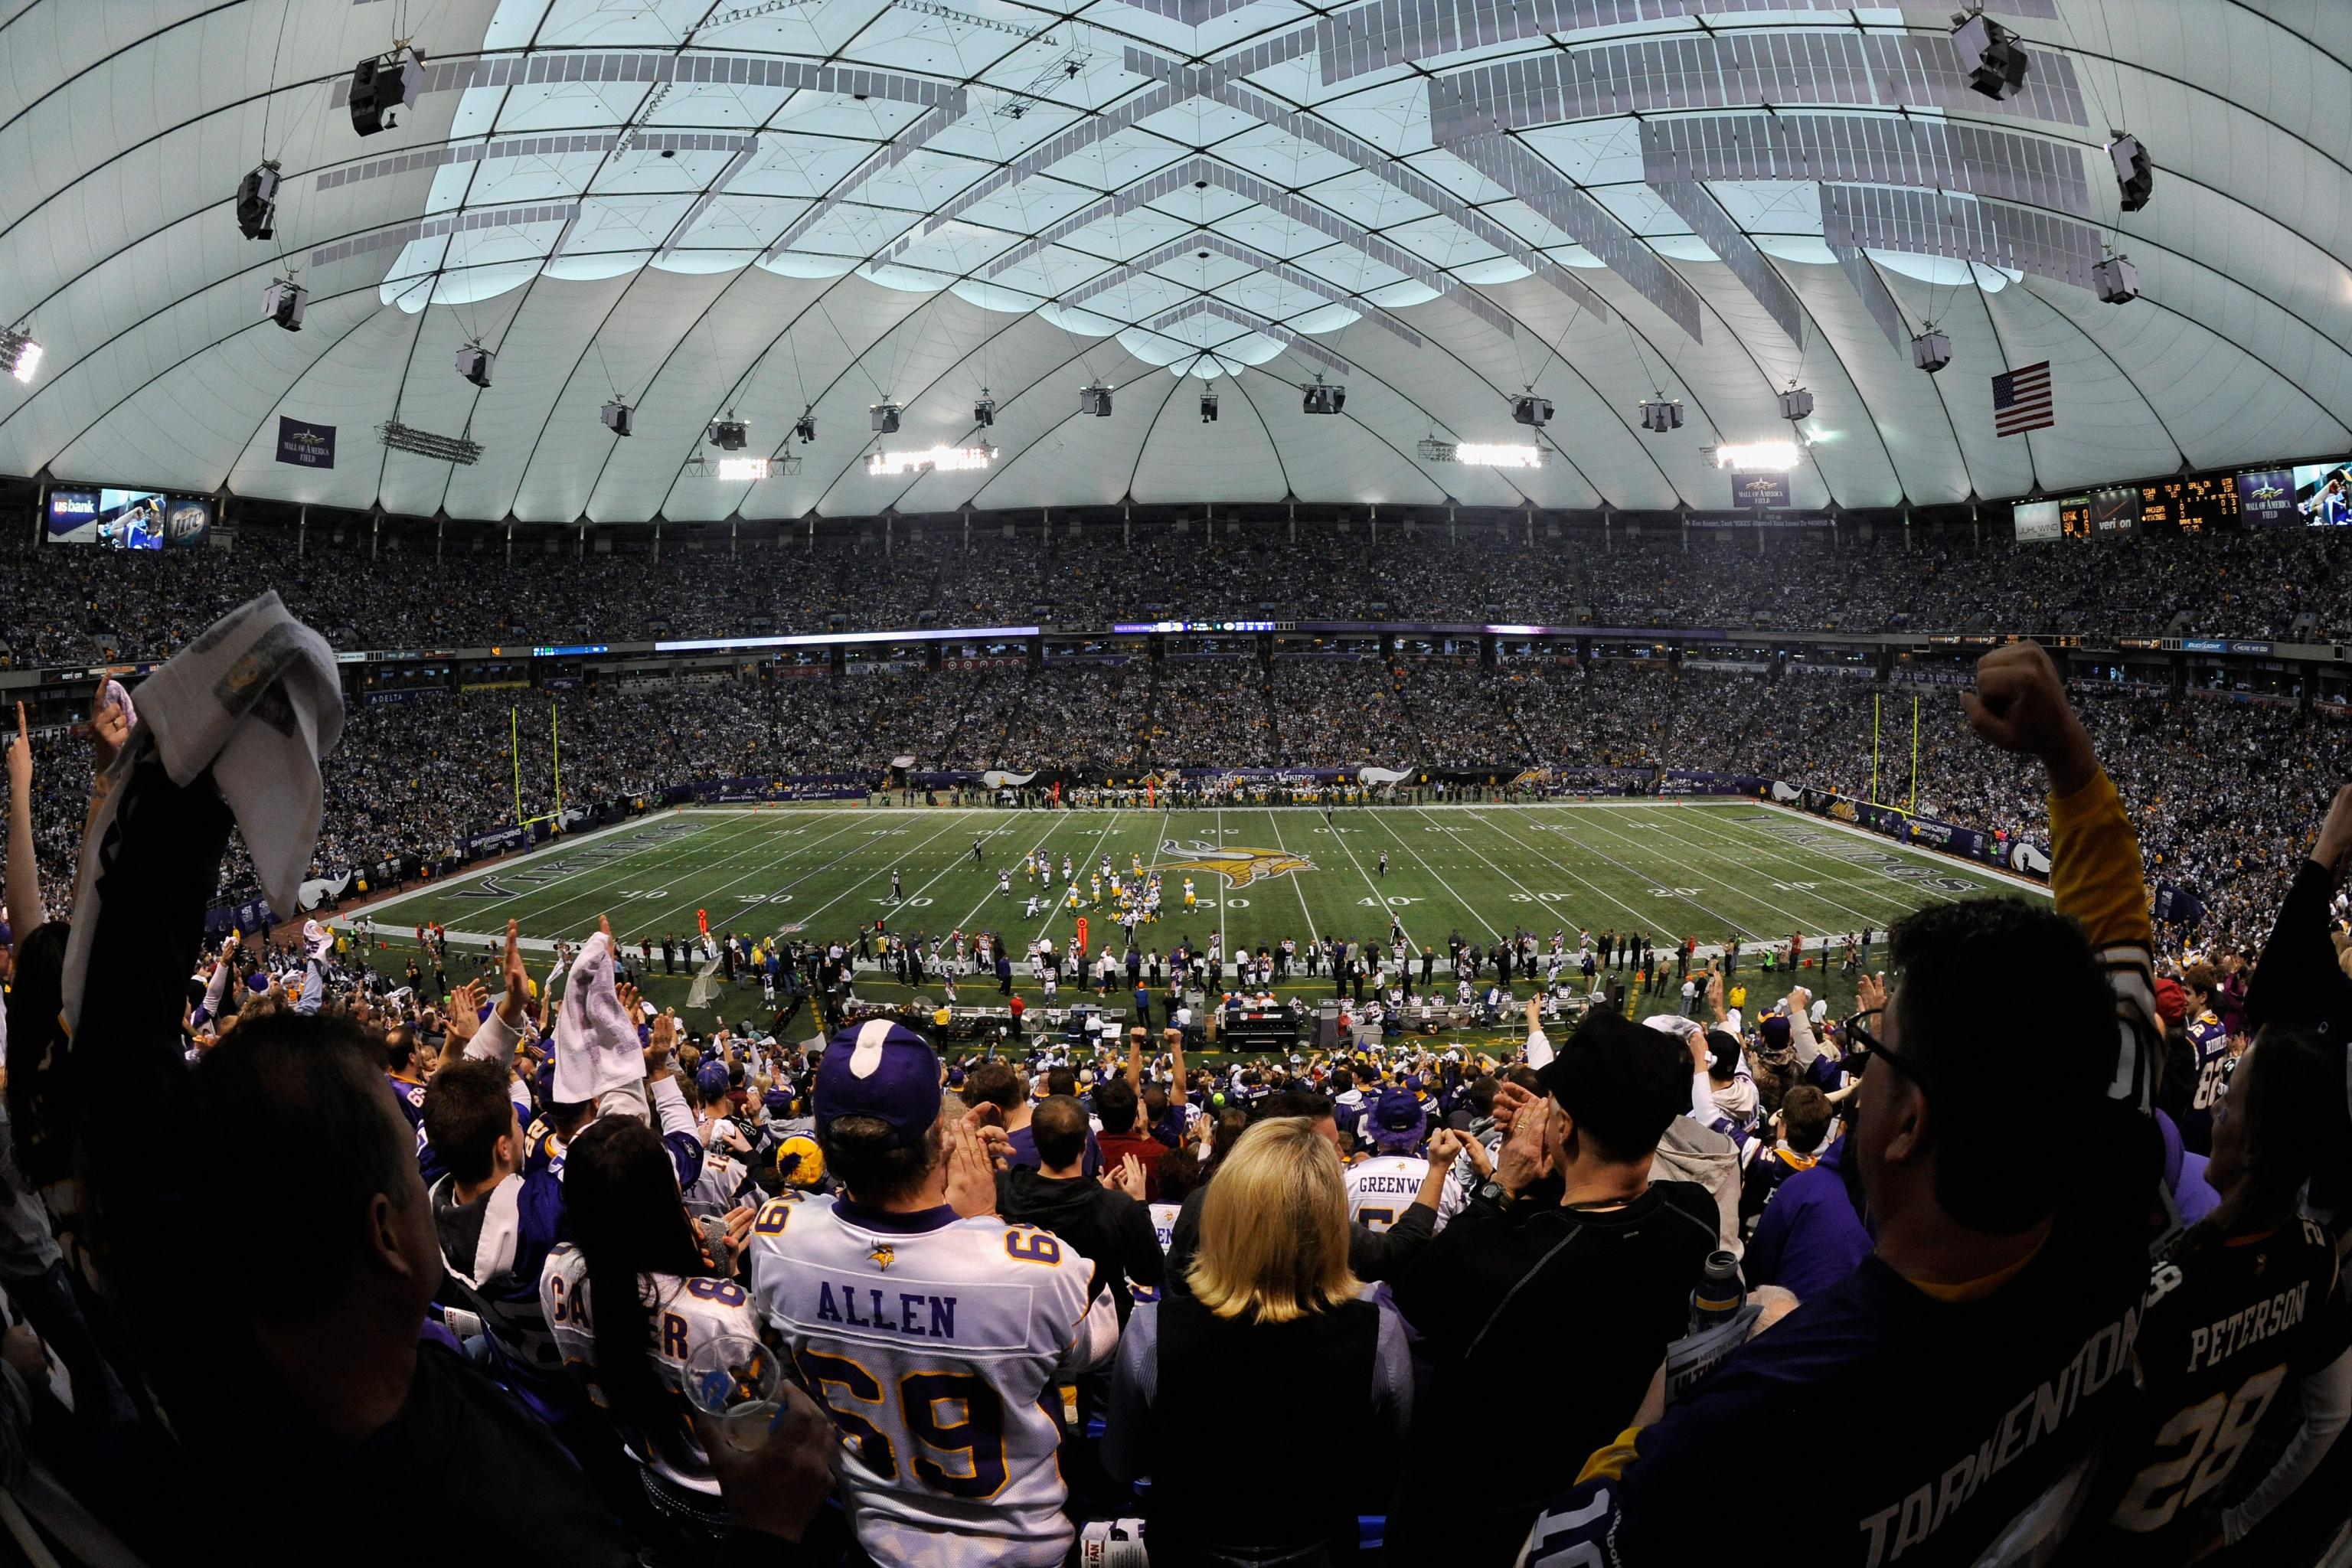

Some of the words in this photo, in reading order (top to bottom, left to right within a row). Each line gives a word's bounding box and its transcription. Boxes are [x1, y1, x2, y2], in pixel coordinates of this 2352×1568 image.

[284, 442, 297, 452] MALL
[306, 444, 329, 456] AMERICA
[300, 453, 315, 462] FIELD
[2266, 499, 2292, 510] AMERICA
[2063, 511, 2077, 521] OAK
[2082, 509, 2089, 519] 0
[2262, 511, 2278, 519] FIELD
[2038, 523, 2058, 533] WIND
[2099, 518, 2132, 531] verion
[2202, 641, 2221, 649] LIGHT
[379, 694, 403, 702] DELTA
[1772, 881, 1815, 891] 10
[1508, 892, 1562, 903] 30
[1647, 887, 1697, 897] 20
[740, 893, 794, 904] 20
[1194, 898, 1250, 908] 50
[1356, 896, 1411, 906] 40
[1360, 1176, 1426, 1194] GREENW
[817, 1282, 957, 1338] ALLEN
[550, 1276, 688, 1360] CAER
[2187, 1281, 2310, 1373] PETERSON
[795, 1348, 1012, 1499] 69
[2108, 1362, 2288, 1533] 28
[1090, 1544, 1099, 1562] FAN
